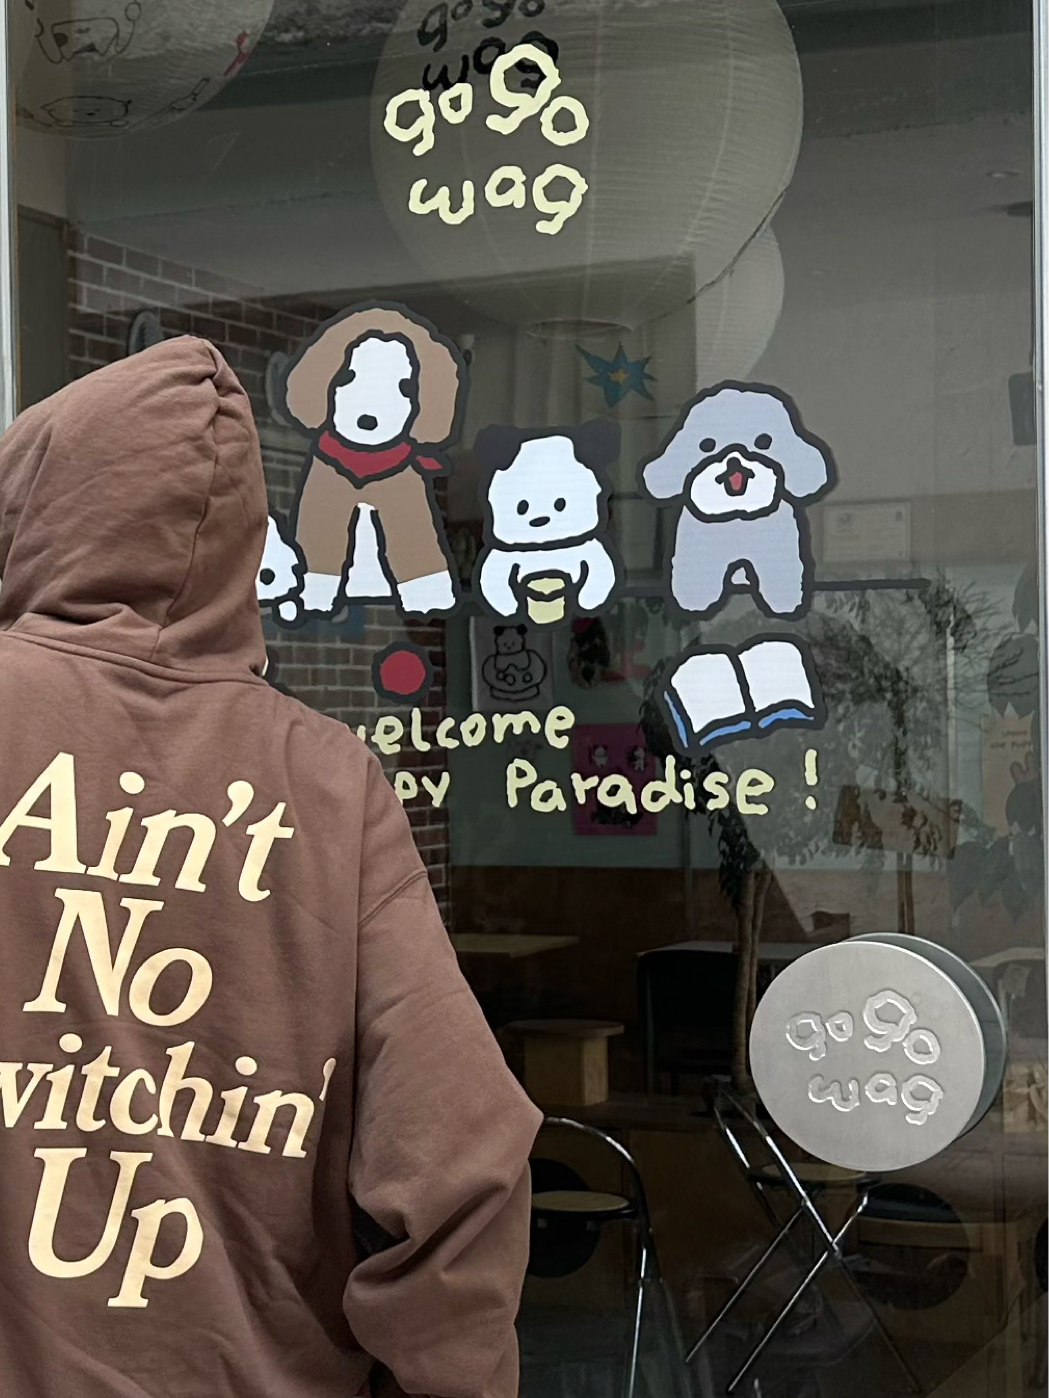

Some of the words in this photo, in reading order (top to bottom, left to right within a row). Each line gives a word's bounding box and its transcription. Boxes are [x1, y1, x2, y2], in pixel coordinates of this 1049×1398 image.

[408, 164, 588, 234] wag
[357, 705, 575, 755] elcome
[506, 754, 775, 815] Paradise
[23, 887, 213, 1027] No
[808, 1073, 944, 1126] wag
[28, 1147, 204, 1308] Up
